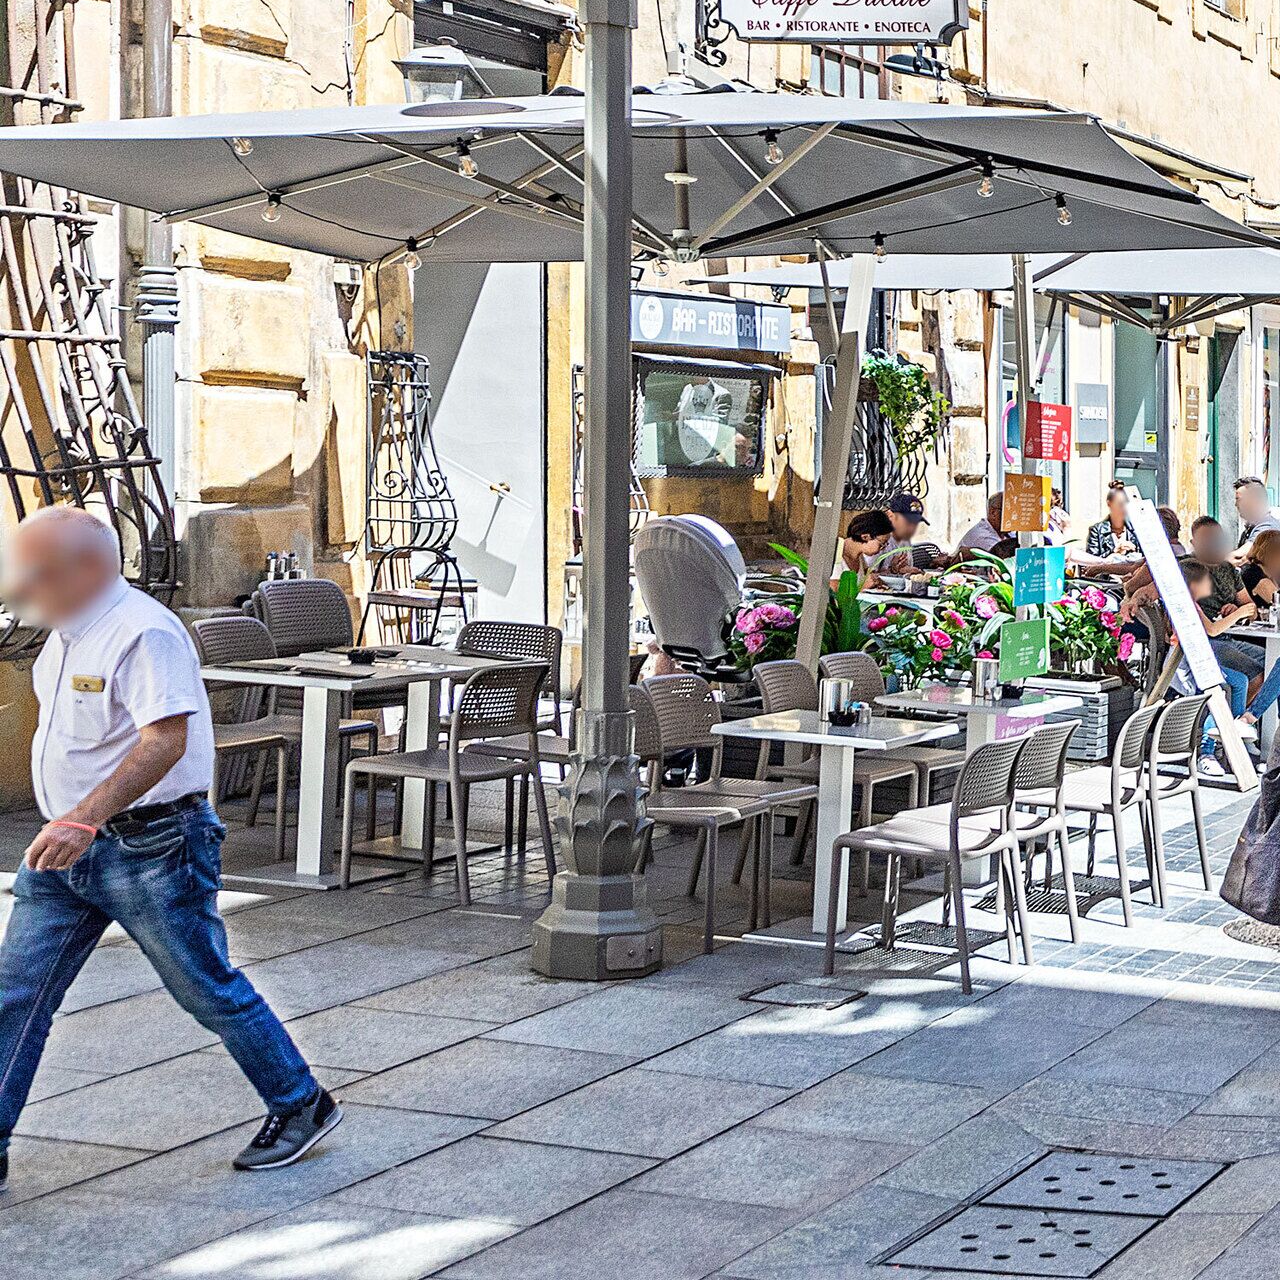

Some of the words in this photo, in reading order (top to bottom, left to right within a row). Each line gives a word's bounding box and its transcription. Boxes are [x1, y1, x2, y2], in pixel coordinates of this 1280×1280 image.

[747, 20, 770, 31] BAR
[786, 21, 860, 32] RISTORANTE
[875, 21, 932, 33] ENOTECA
[671, 307, 697, 332] BAR
